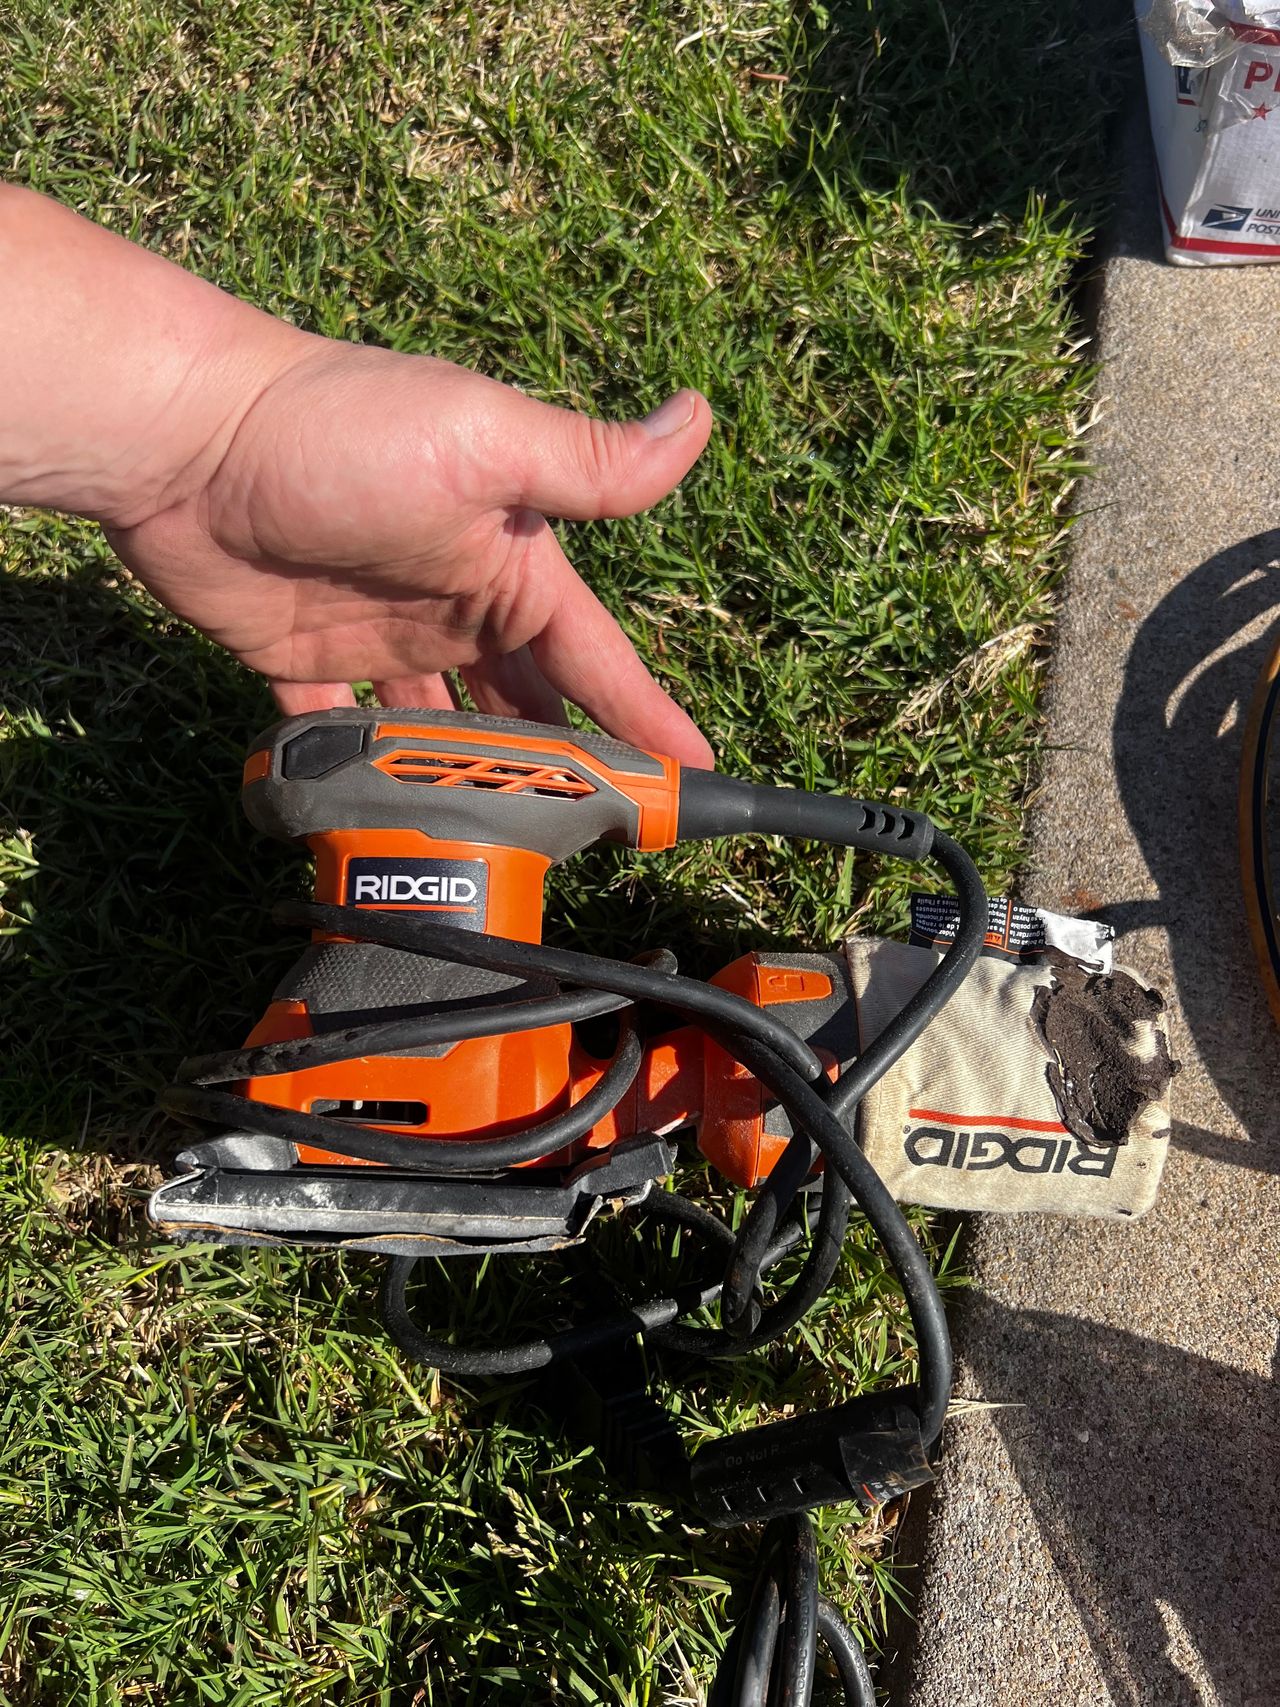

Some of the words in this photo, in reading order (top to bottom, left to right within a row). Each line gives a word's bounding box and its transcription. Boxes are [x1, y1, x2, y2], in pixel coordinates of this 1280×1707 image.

[1244, 61, 1280, 92] P
[355, 875, 478, 903] RIDGID
[903, 1126, 1119, 1179] RIDGID
